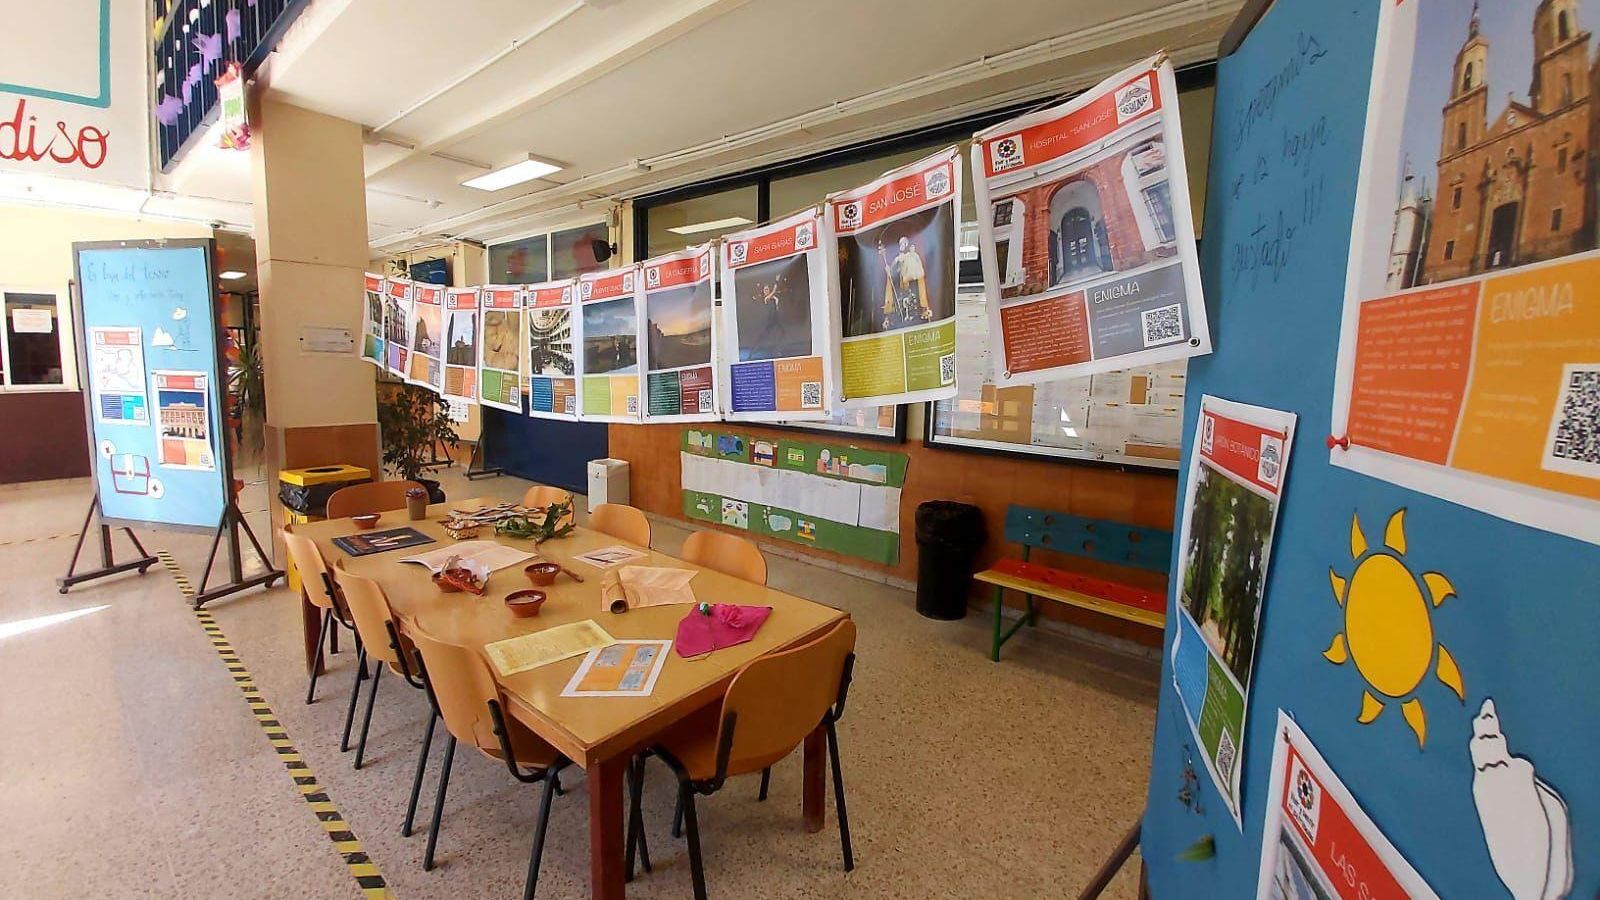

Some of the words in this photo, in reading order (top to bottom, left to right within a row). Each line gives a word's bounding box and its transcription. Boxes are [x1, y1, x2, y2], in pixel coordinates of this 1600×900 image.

[1030, 133, 1067, 150] HOSPITAL
[868, 198, 888, 214] SAN
[1094, 281, 1140, 304] ENIGMA
[1491, 282, 1574, 324] ENIGMA
[908, 330, 941, 346] ENIGMA
[1331, 842, 1356, 887] LAS
